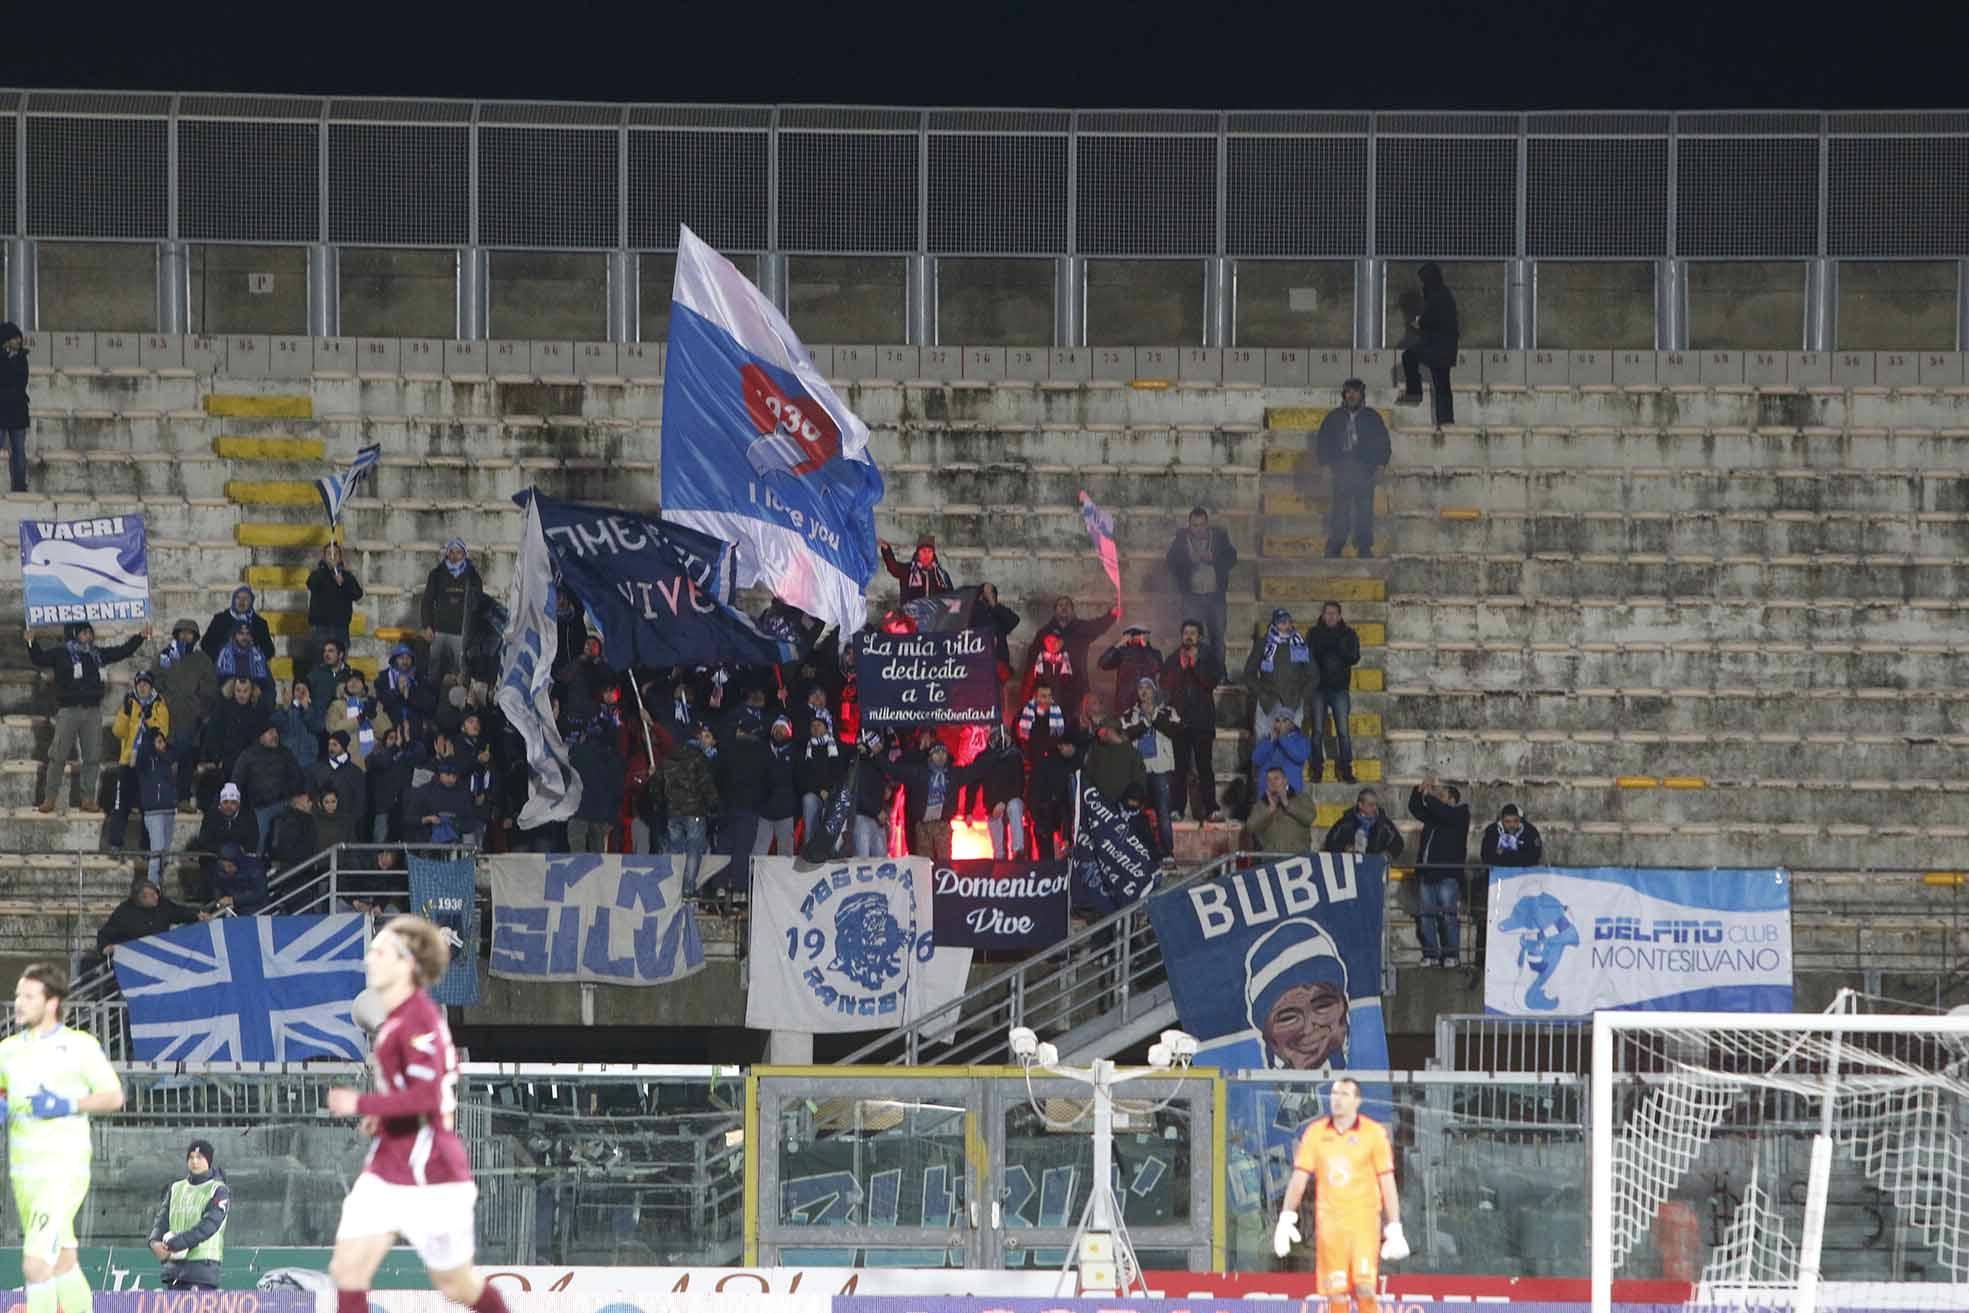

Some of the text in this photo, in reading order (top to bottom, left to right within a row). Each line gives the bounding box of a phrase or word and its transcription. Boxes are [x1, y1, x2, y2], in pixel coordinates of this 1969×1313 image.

[37, 517, 124, 540] VACRI
[808, 517, 840, 551] you
[617, 575, 716, 620] VIVE
[29, 600, 145, 623] PRESENTE
[862, 630, 985, 656] La mia vita
[881, 657, 968, 680] dedicata
[901, 681, 947, 703] a te
[1101, 839, 1145, 878] mondo
[966, 908, 1036, 935] Vive
[1594, 917, 1780, 944] DELFINO CLUB
[786, 926, 826, 961] 19
[1591, 946, 1781, 973] MONTESILVANO
